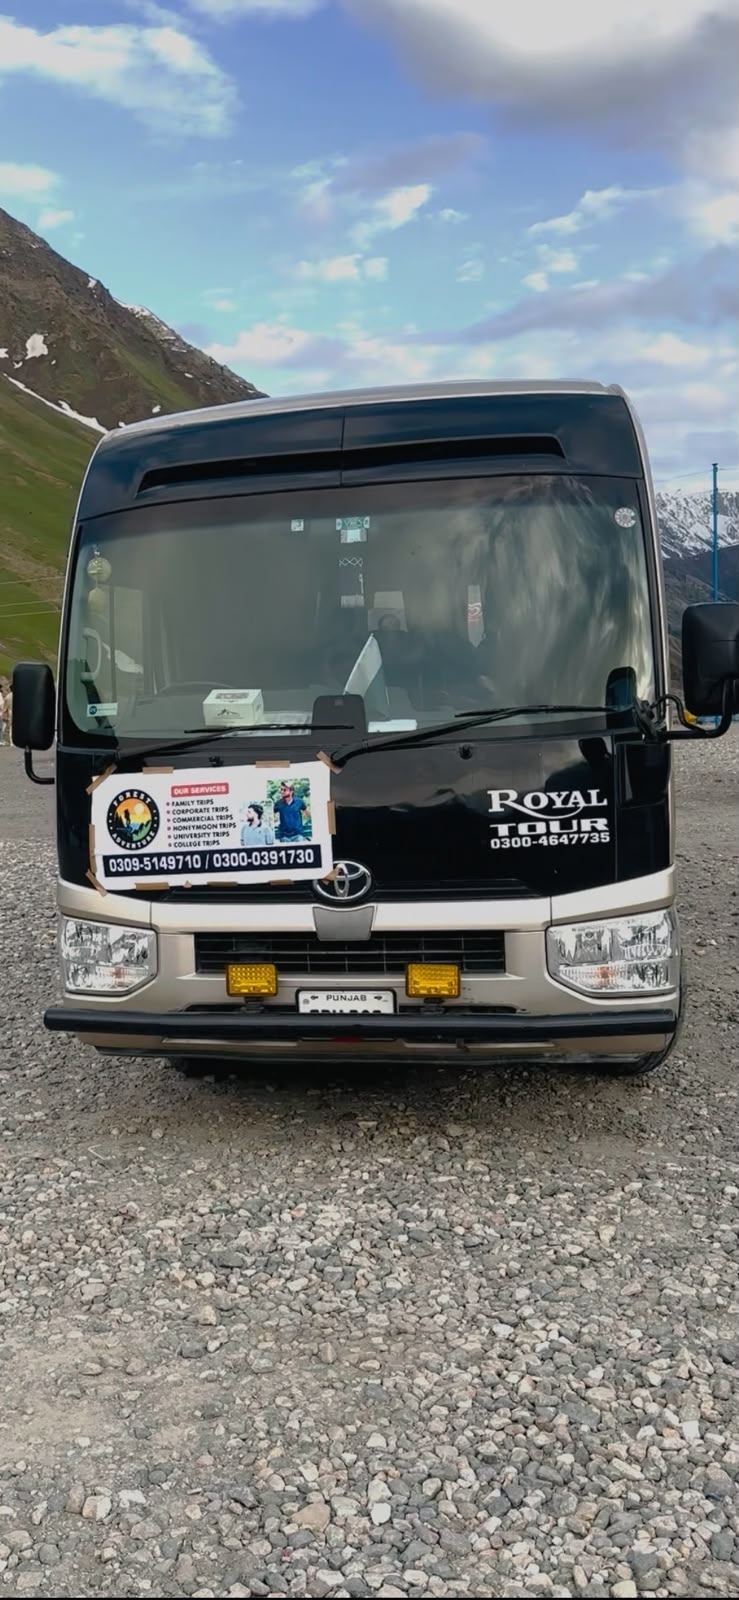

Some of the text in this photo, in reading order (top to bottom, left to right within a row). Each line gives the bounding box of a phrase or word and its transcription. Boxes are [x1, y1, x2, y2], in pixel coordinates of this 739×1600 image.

[173, 785, 227, 795] OUR SERVICES
[113, 791, 151, 806] FOREST
[487, 789, 608, 819] ROYAL
[172, 823, 218, 831] HONEYMOON
[489, 818, 609, 837] TOUR
[173, 832, 211, 840] UNIVERSITY
[490, 832, 610, 849] 0300-4647735
[173, 840, 201, 848] COLLEGE
[109, 849, 314, 872] 0309-5149710 / 0300-0391730
